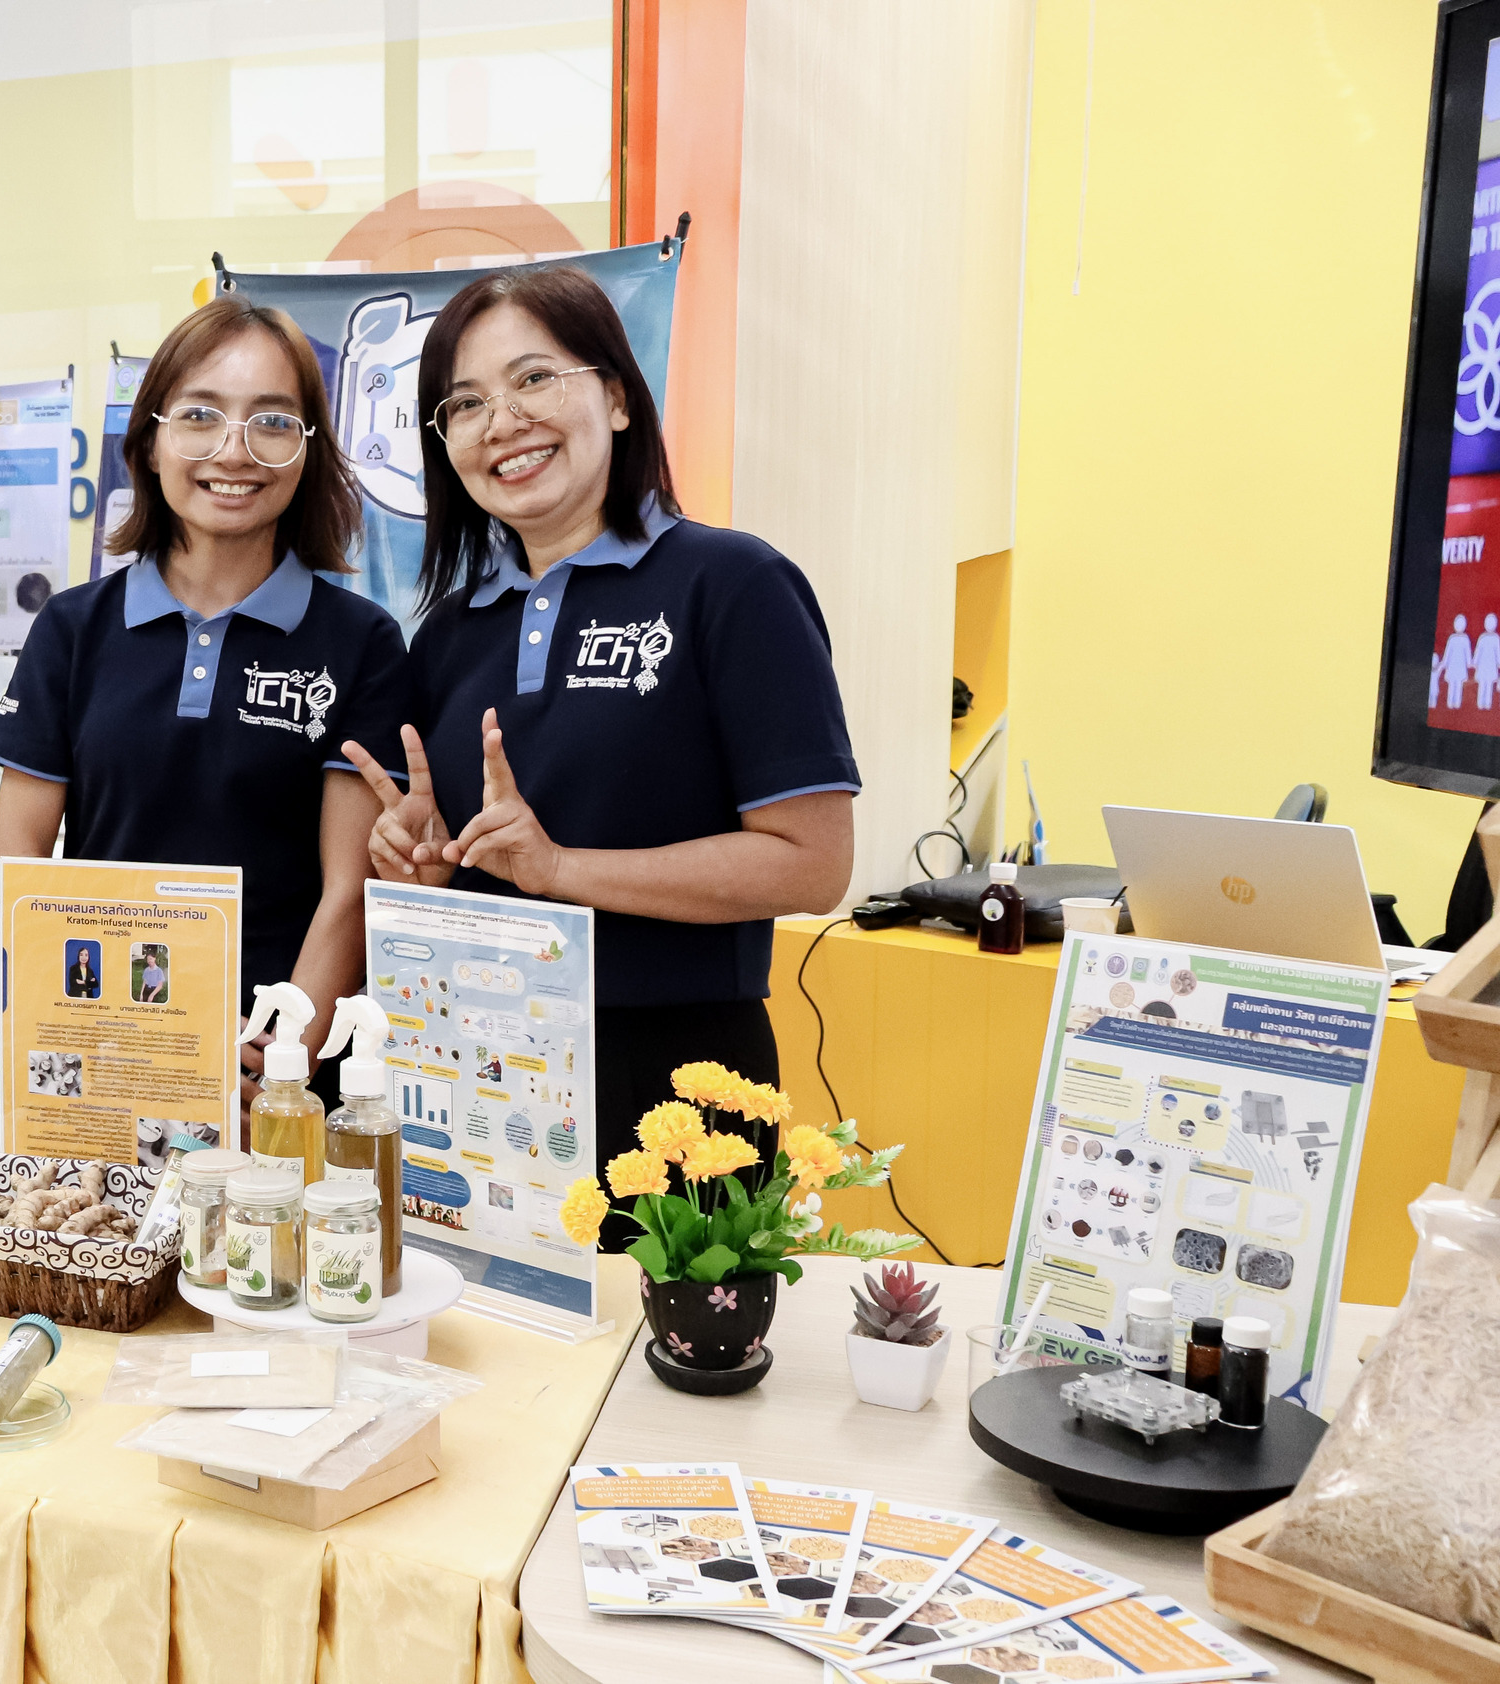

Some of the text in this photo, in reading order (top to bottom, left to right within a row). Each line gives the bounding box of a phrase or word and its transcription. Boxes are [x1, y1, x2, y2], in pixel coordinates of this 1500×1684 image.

[1442, 535, 1485, 565] VERTY
[30, 899, 208, 921] กำยานผสมสารสกัดจากใบกระท่อม
[66, 916, 168, 930] Kratom-Infused Incense
[1232, 1000, 1372, 1031] กลุ่มพลังงาน วัสดุ เคมีชีวภาพ
[1260, 1021, 1339, 1041] และอุตสาหกรรม
[318, 1269, 362, 1286] HERBAL
